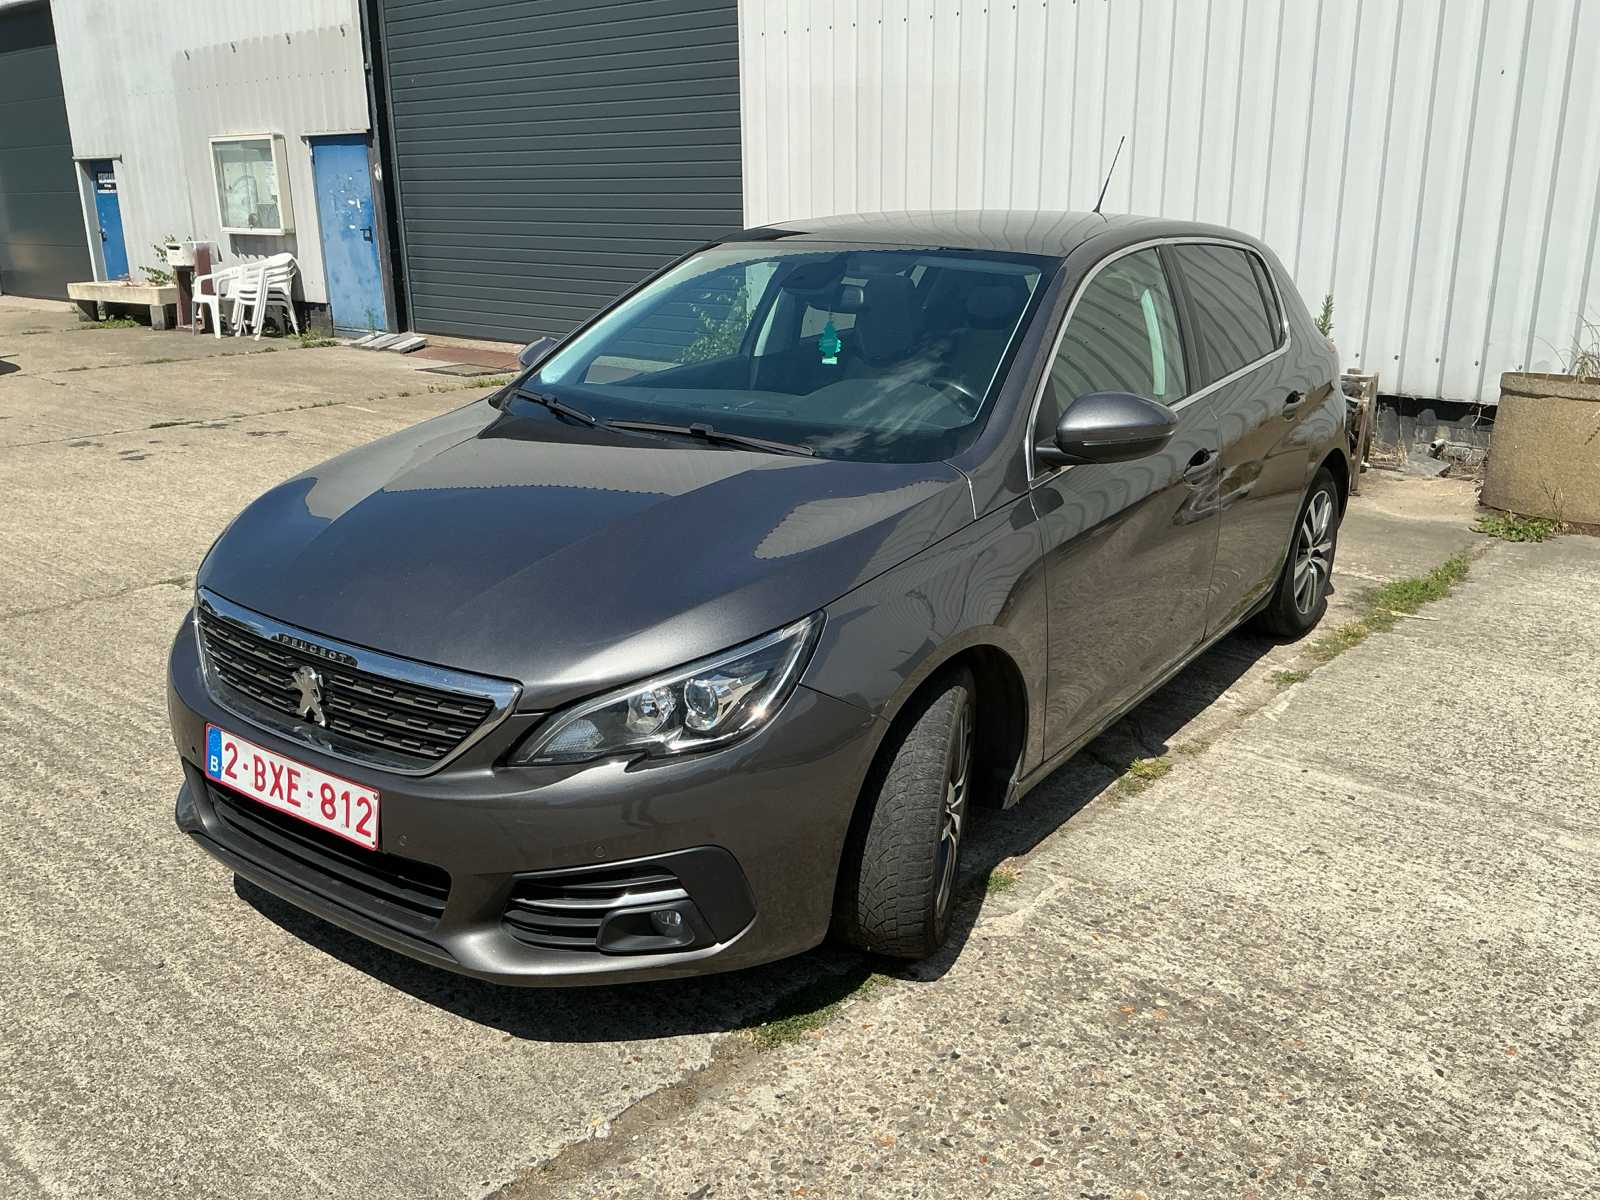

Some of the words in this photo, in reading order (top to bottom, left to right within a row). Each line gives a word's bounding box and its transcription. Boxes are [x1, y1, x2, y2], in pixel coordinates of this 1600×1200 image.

[282, 635, 347, 663] PEUGEOT
[210, 755, 219, 772] B
[224, 742, 373, 838] 2-BXE-812
